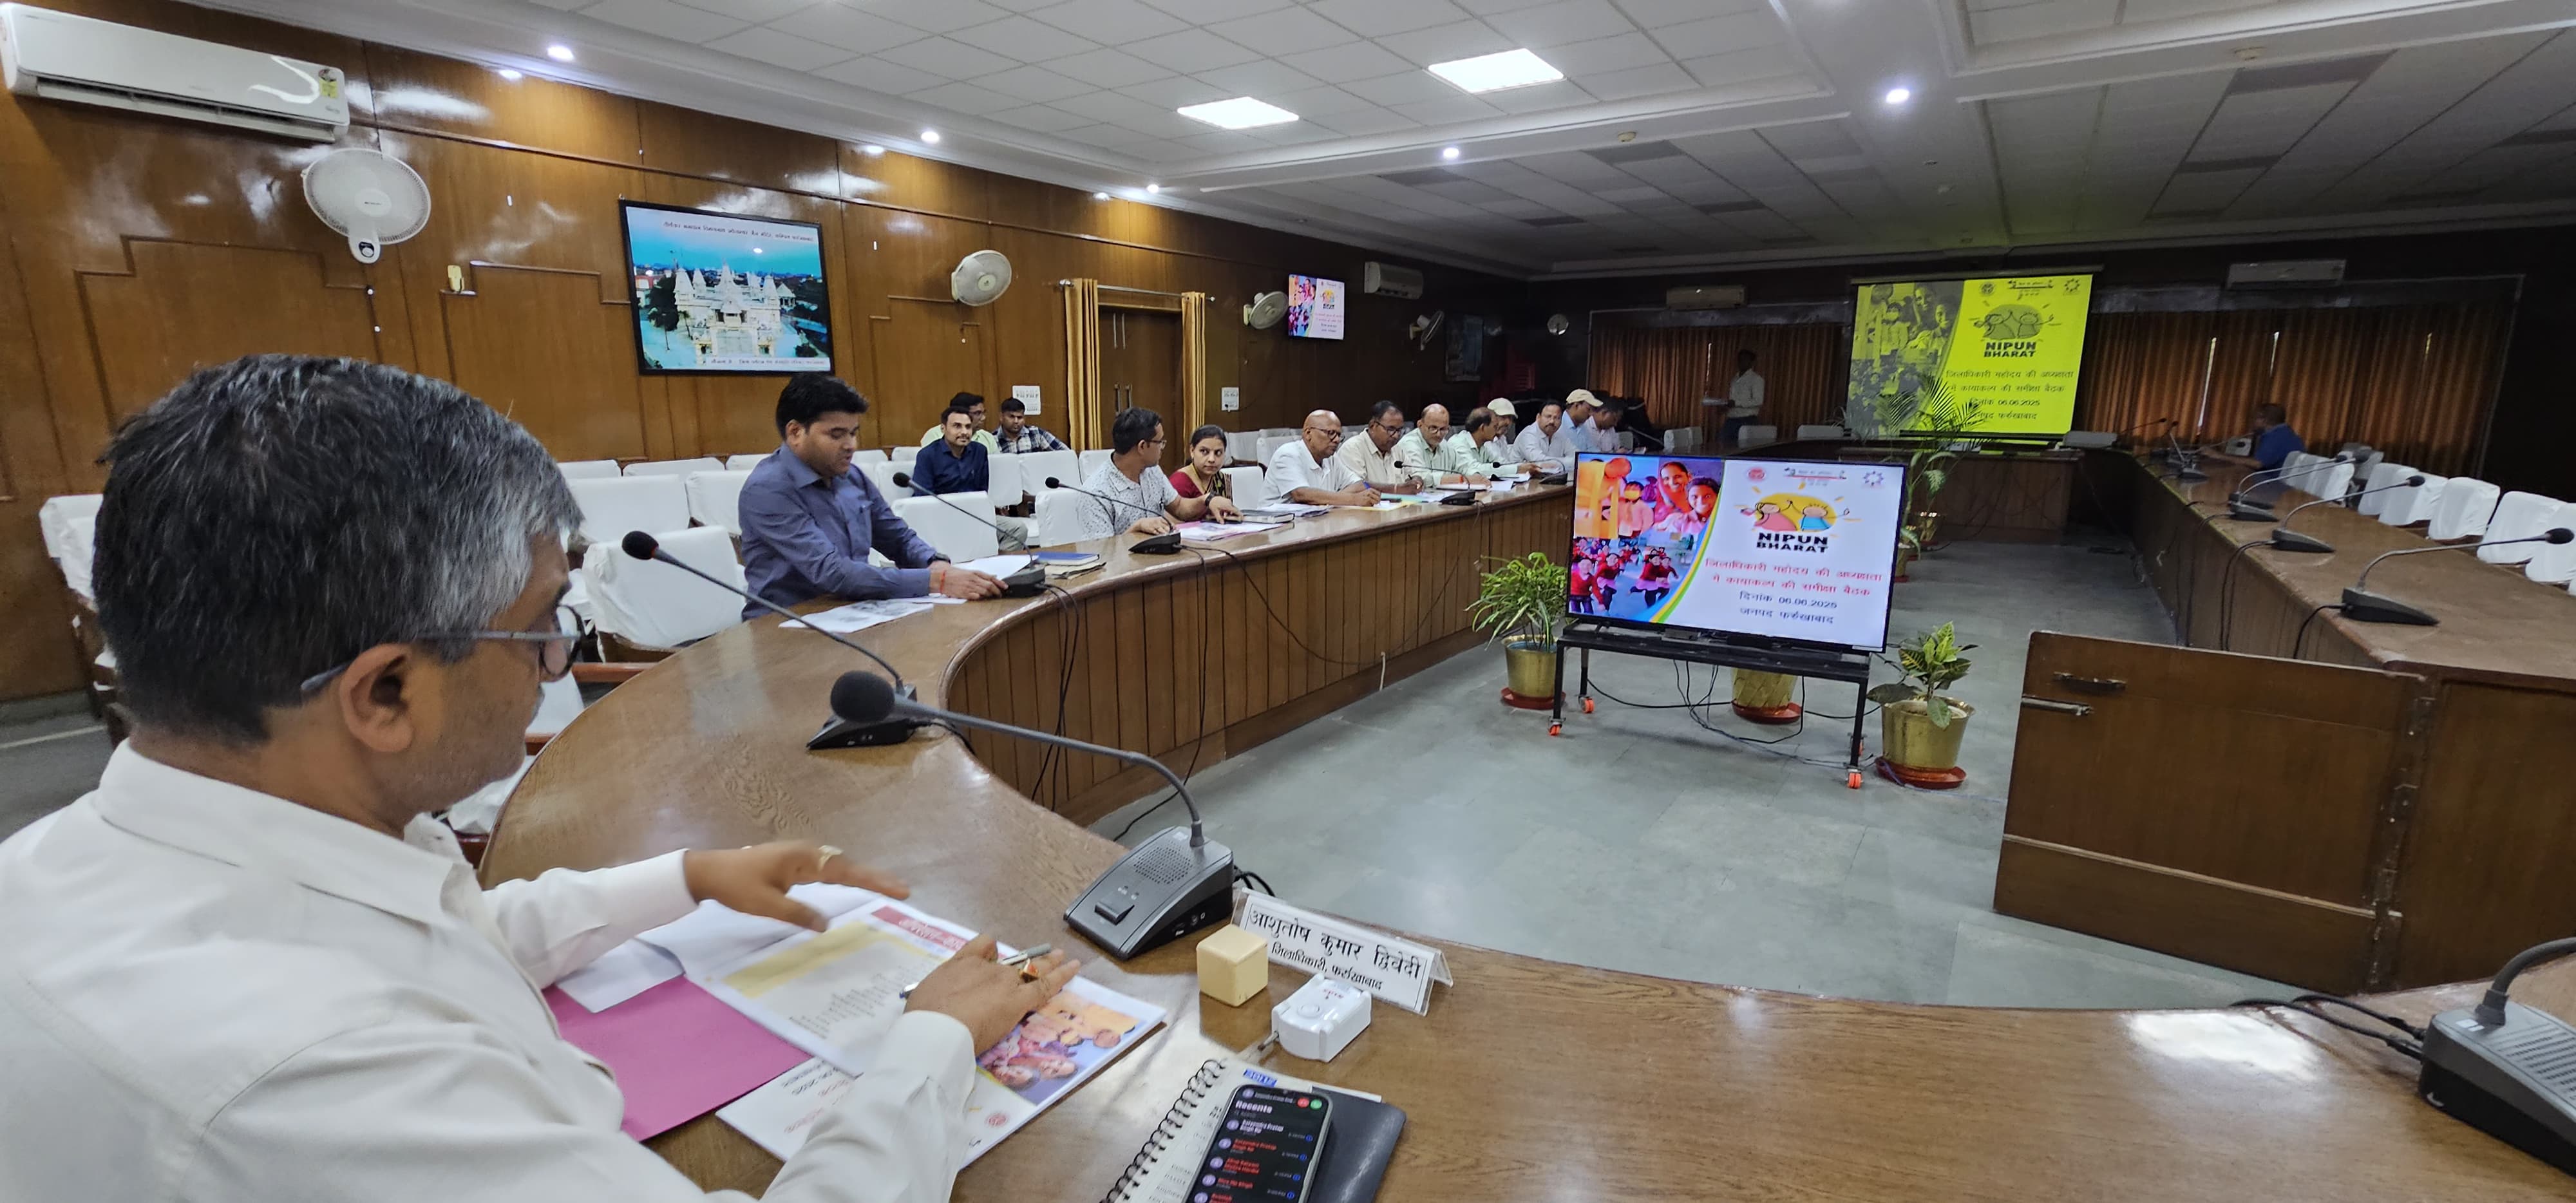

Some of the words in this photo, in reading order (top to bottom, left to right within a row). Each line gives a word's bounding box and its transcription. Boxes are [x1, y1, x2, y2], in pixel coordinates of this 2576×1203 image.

[1985, 341, 2036, 350] NIPUN
[2025, 369, 2036, 378] की
[2001, 383, 2011, 392] की
[1758, 532, 1828, 545] NIPUN
[1756, 542, 1829, 553] BHARAT
[1705, 558, 1766, 573] जिलाधिकारी
[1774, 563, 1809, 576] महोदय
[1815, 567, 1830, 578] की
[1781, 580, 1795, 590] की
[1778, 596, 1838, 609] 06.06.2025
[1250, 910, 1311, 943] आशुतोष
[1321, 933, 1364, 961] कुमार
[1373, 944, 1422, 980] द्विवेदी
[1271, 941, 1328, 973] जिलाधिकारी,
